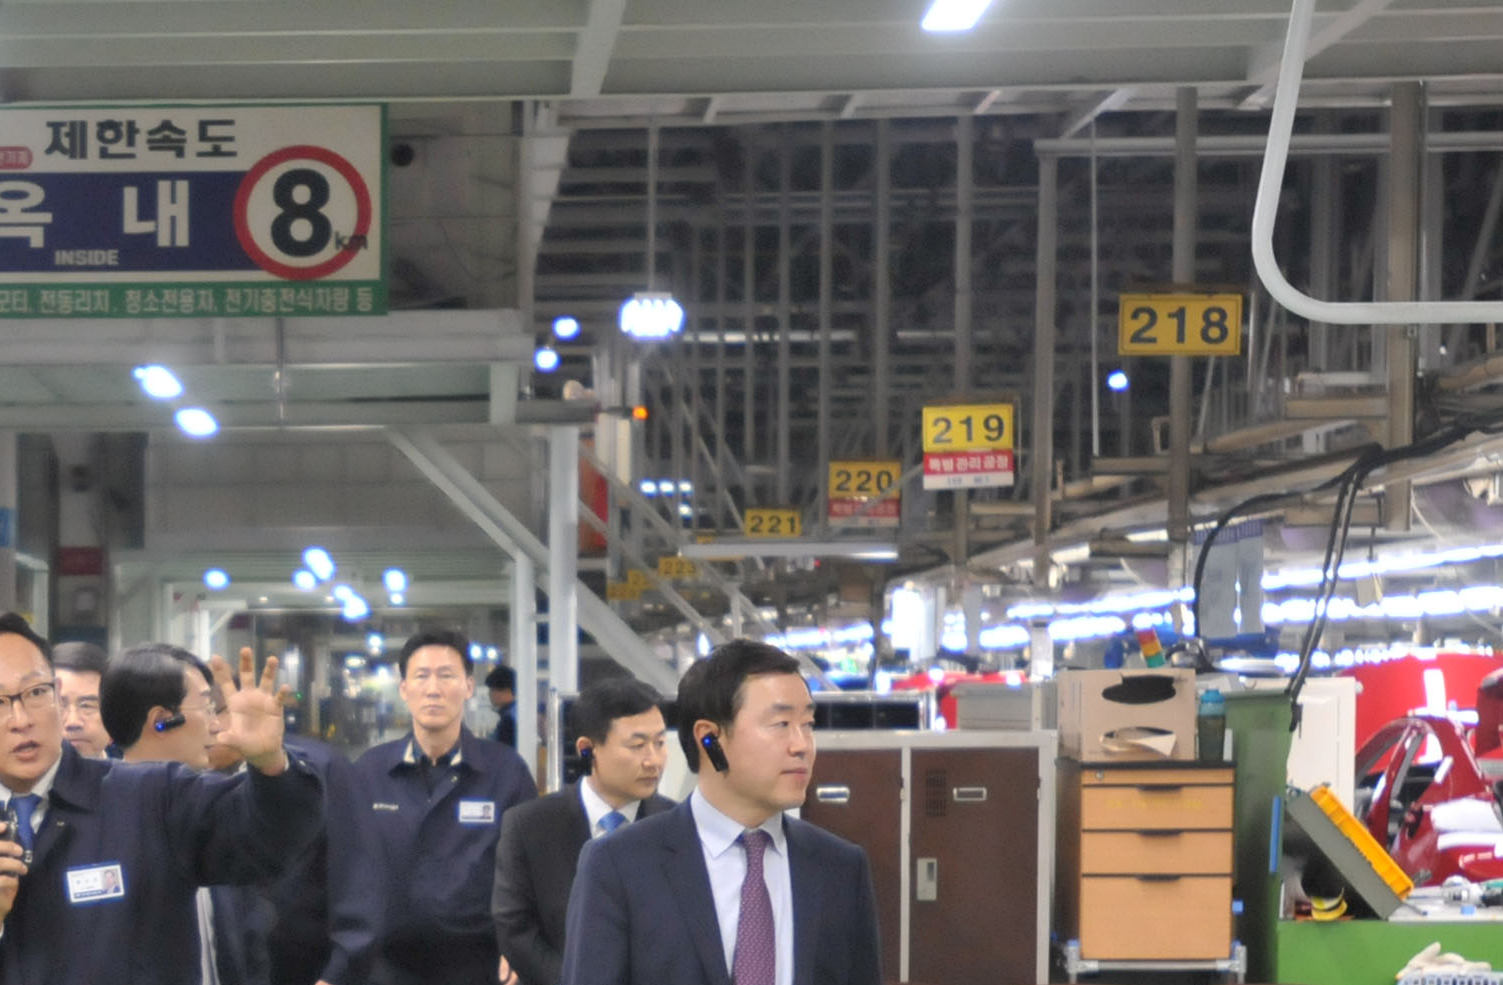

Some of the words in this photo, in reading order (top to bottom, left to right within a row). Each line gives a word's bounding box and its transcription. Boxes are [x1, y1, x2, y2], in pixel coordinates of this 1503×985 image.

[45, 119, 238, 160] 제한속도
[270, 168, 332, 258] 8
[335, 231, 368, 250] km
[55, 249, 119, 266] INSIDE
[356, 287, 373, 312] 등
[1129, 306, 1229, 345] 218
[932, 413, 1005, 444] 219
[835, 469, 893, 493] 220
[749, 515, 797, 533] 221
